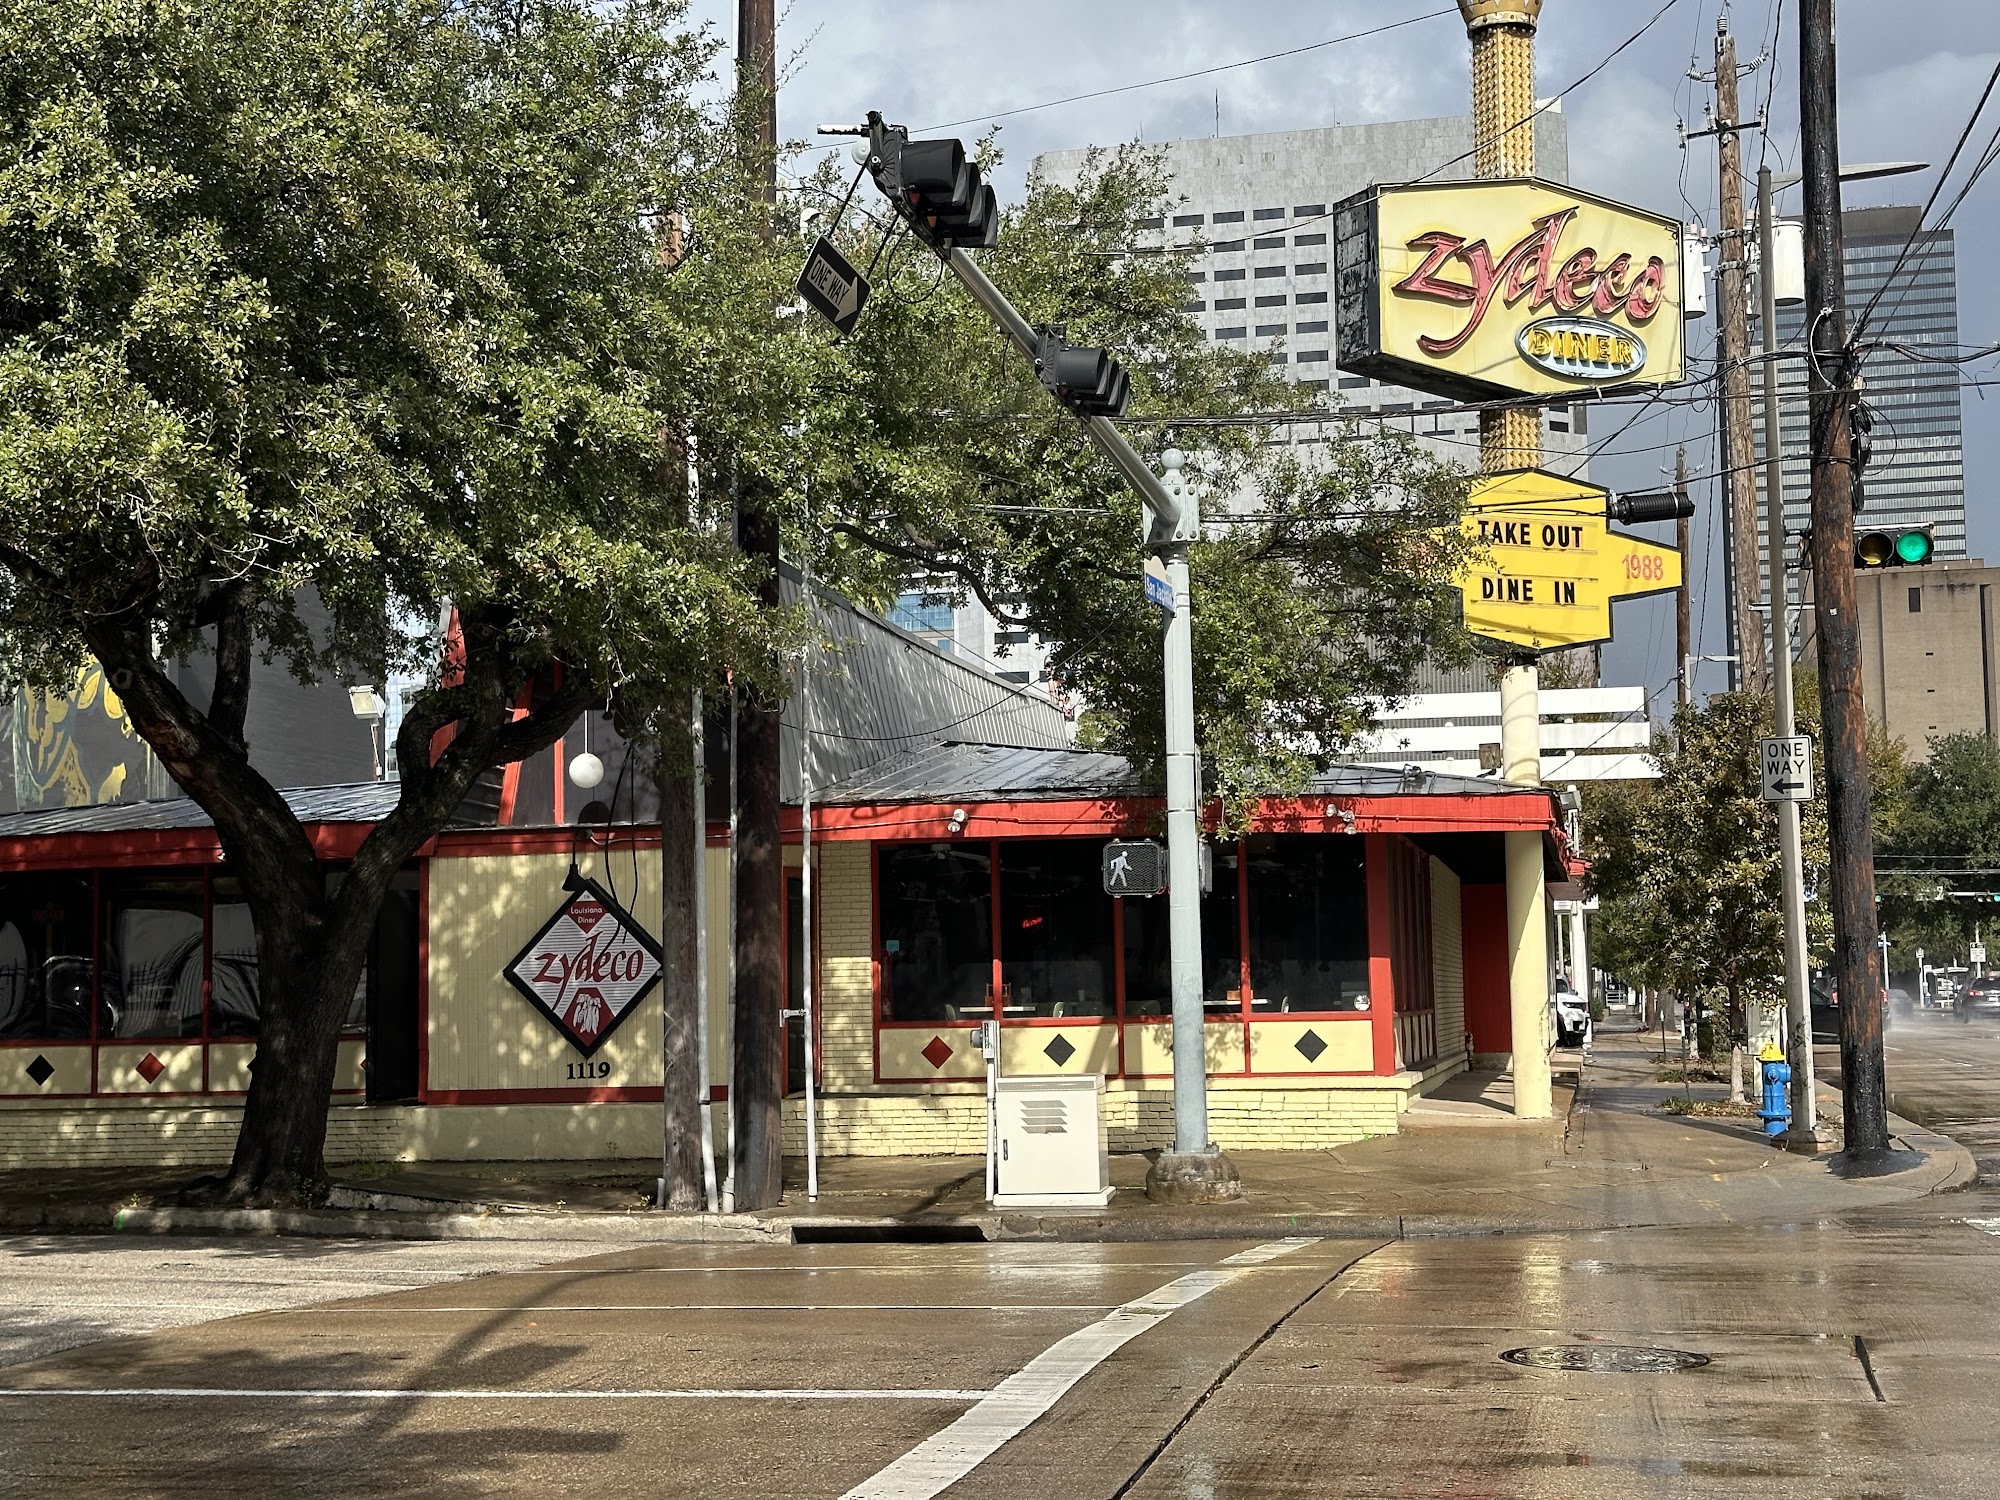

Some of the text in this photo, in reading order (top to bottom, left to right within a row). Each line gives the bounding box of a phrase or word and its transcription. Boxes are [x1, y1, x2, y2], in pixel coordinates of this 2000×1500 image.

[810, 259, 850, 306] ONE WAY
[1529, 326, 1635, 366] DINER
[1478, 520, 1583, 548] TAKE OUT
[1622, 554, 1664, 581] 1988
[1482, 577, 1576, 604] DINE IN
[1768, 742, 1804, 758] ONE
[1766, 760, 1805, 775] WAY
[570, 906, 603, 915] Louisiana
[577, 916, 596, 924] Diner
[567, 1061, 611, 1080] 1119
